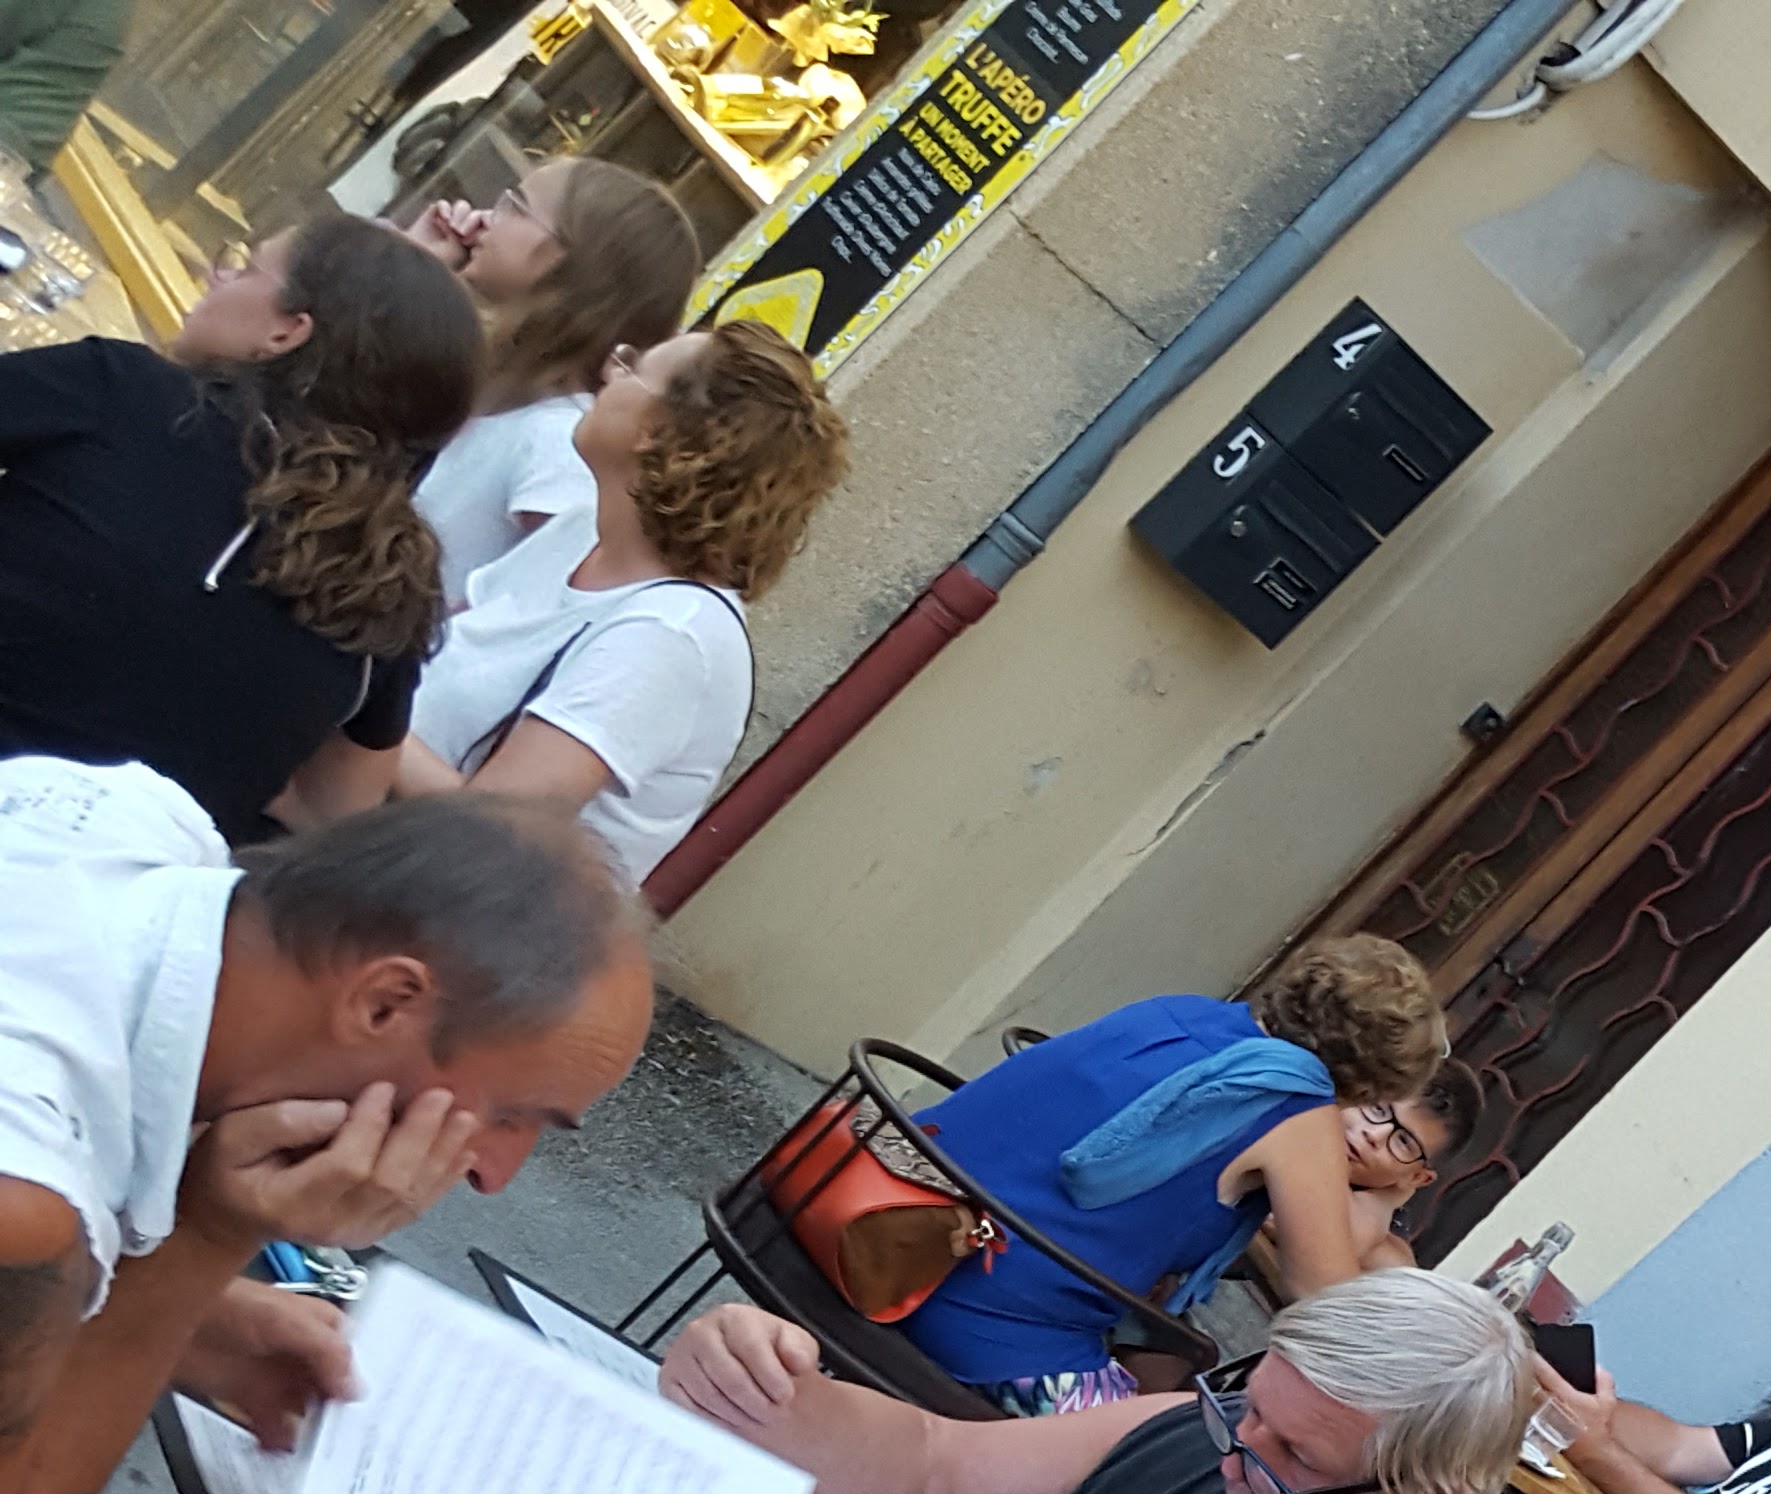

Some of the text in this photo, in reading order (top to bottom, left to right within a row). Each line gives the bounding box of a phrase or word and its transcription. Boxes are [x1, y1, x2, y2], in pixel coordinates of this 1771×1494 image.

[938, 69, 1024, 157] TRUFFE
[963, 43, 1048, 126] L'APÉRO
[908, 135, 974, 196] PARTAGER
[918, 102, 938, 128] UN
[934, 122, 991, 174] MOMENT
[1332, 322, 1384, 371] 4
[1212, 426, 1267, 479] 5
